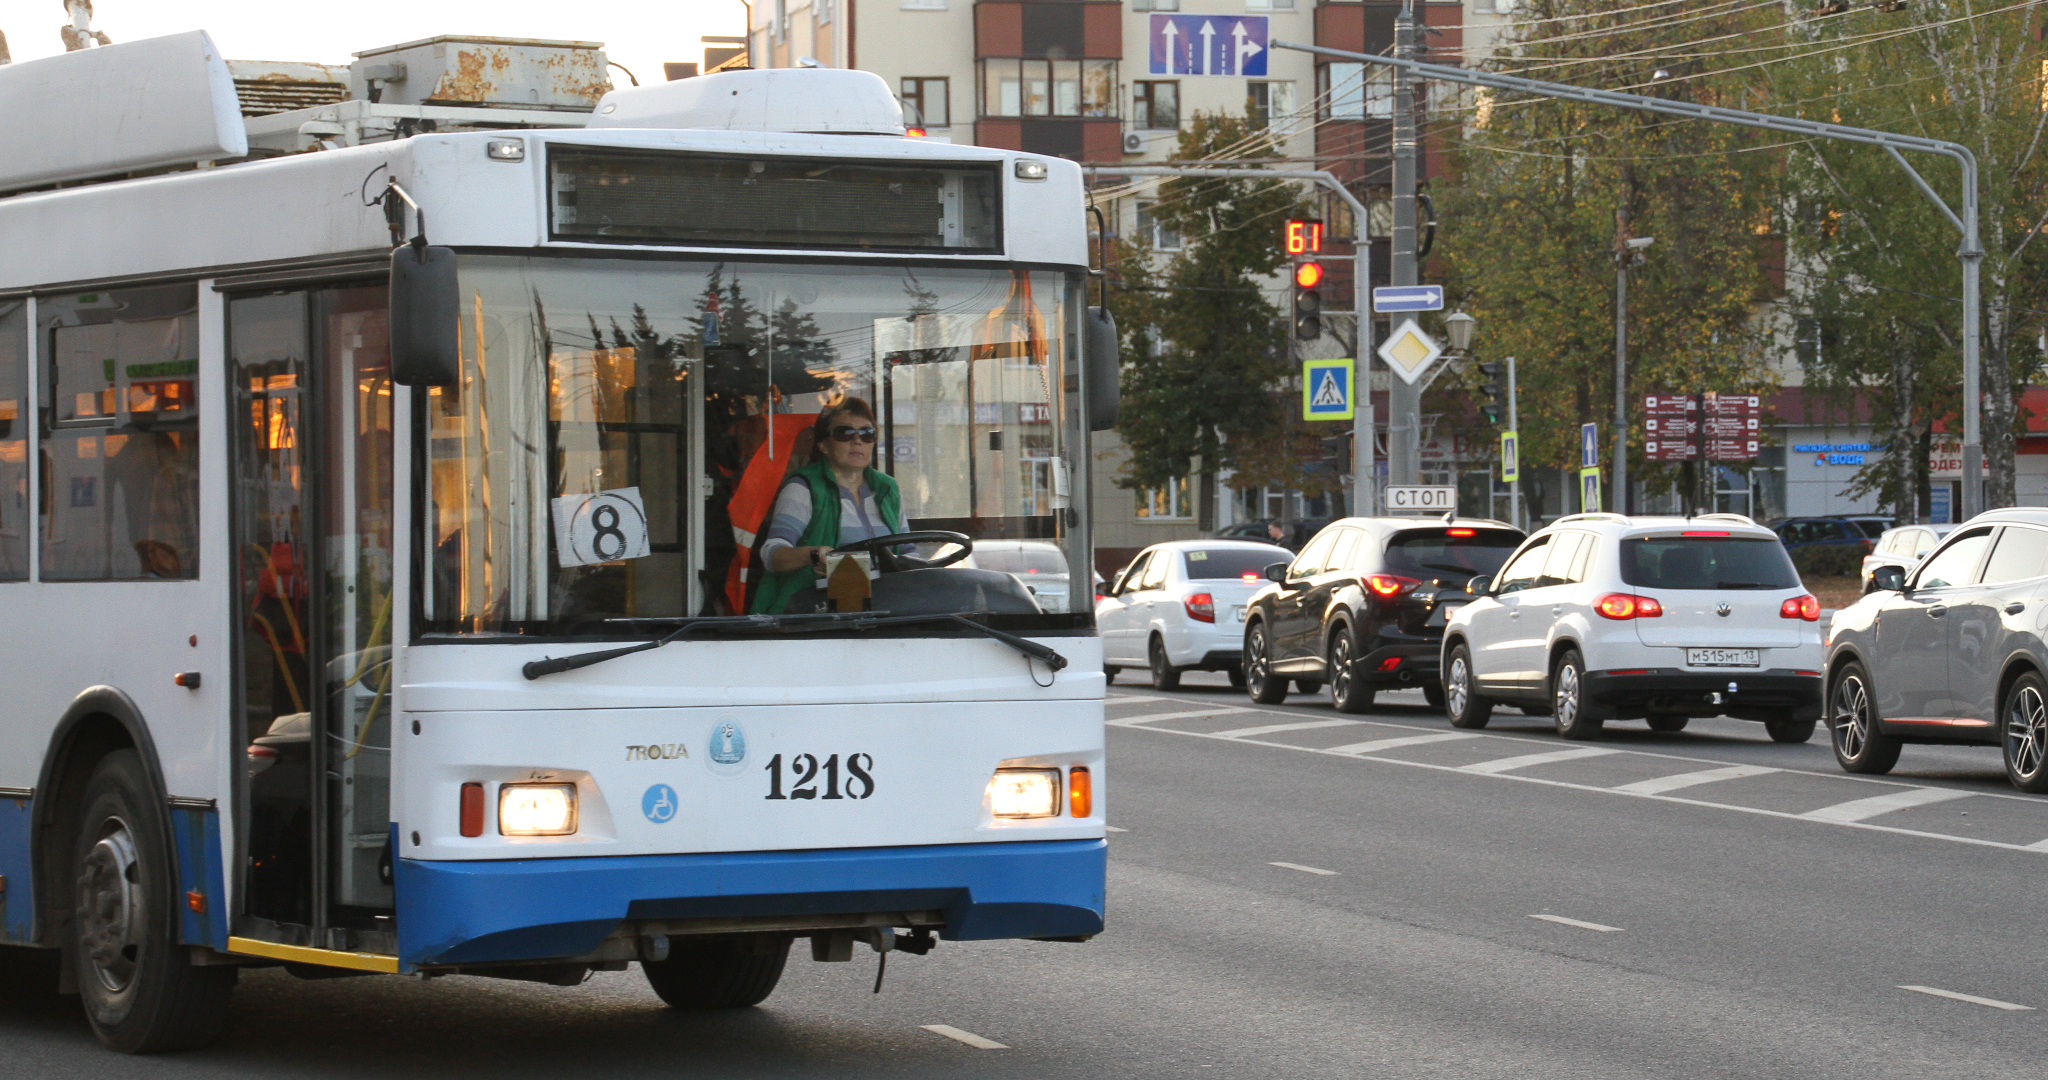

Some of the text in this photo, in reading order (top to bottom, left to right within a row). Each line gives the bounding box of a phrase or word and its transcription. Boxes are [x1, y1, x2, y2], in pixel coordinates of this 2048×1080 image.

[1287, 222, 1320, 253] 61
[1395, 490, 1447, 505] СТОП
[591, 504, 627, 561] 8
[1692, 650, 1755, 662] М515МТ 13
[626, 743, 690, 761] TROLZA
[765, 753, 875, 800] 1218
